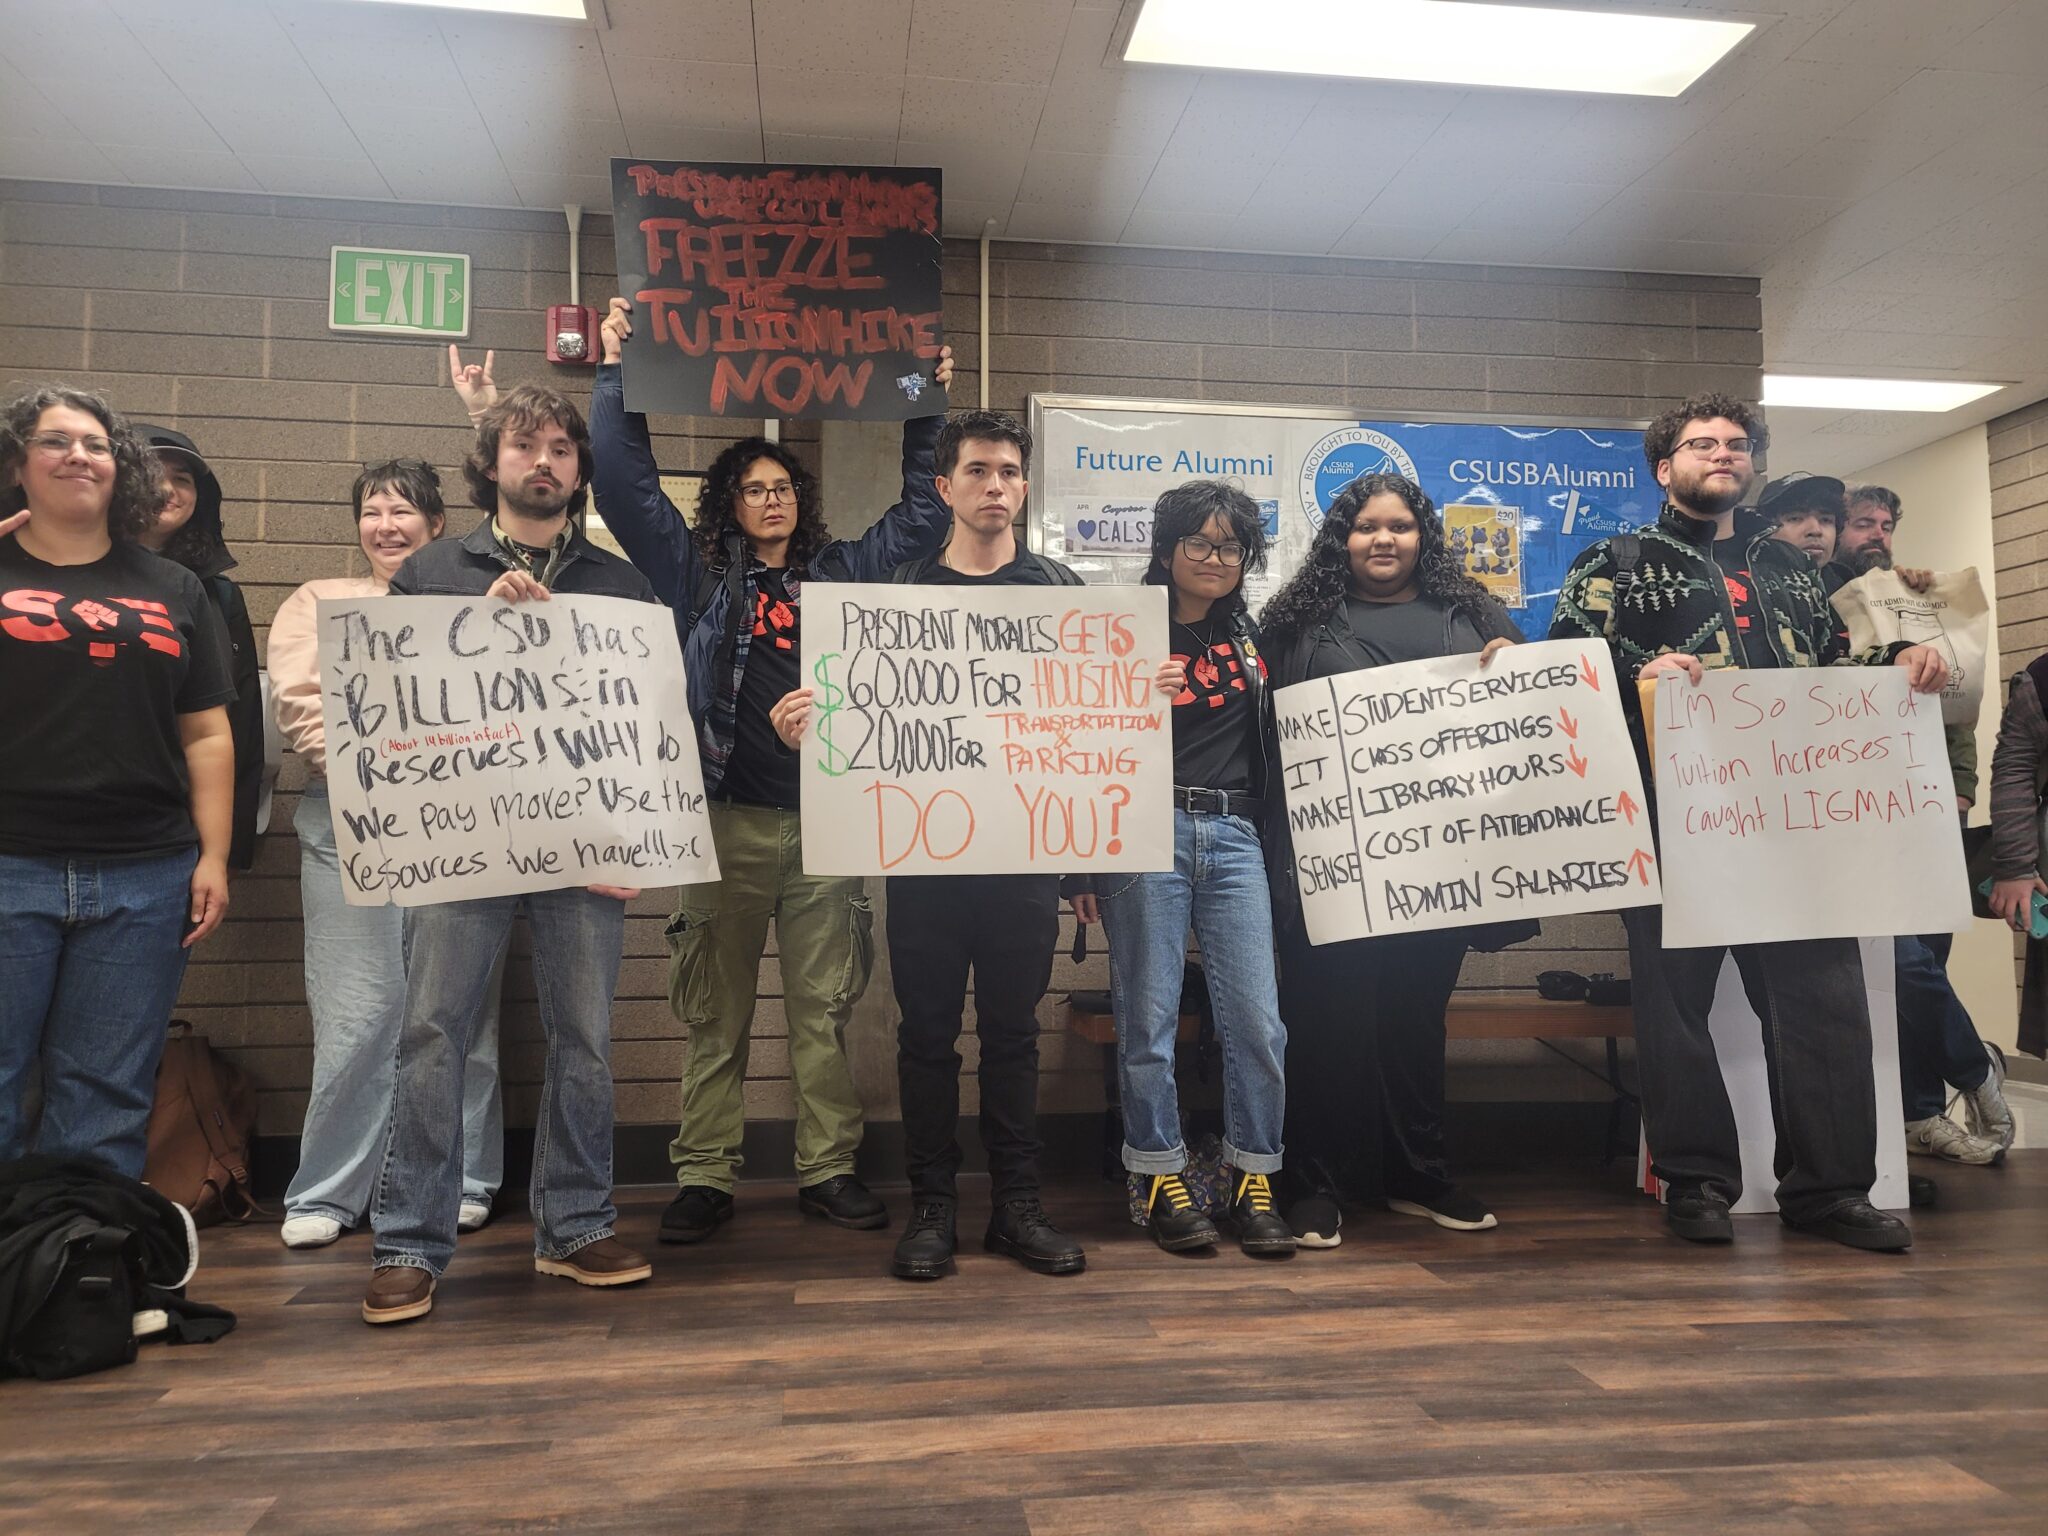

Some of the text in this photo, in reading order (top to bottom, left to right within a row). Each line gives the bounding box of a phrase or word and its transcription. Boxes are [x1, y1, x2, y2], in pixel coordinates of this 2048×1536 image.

[354, 258, 453, 327] EXIT
[710, 352, 874, 415] NOW
[1075, 446, 1274, 476] Future Alumni
[1304, 433, 1345, 481] BROUGHT
[1346, 431, 1362, 441] TO
[1365, 432, 1391, 450] YOU
[1389, 447, 1406, 460] BY
[1321, 465, 1354, 475] Alumni
[1331, 461, 1354, 469] CSUSB
[1497, 510, 1514, 521] $20
[1870, 599, 1883, 608] CUT
[331, 605, 651, 663] The CSU has
[841, 601, 959, 651] PRESIDENT
[966, 613, 1059, 654] MORALES
[1058, 608, 1137, 658] GETS
[598, 668, 639, 707] in
[1030, 657, 1153, 709] HOUSING
[1733, 682, 1787, 730] So
[425, 735, 436, 748] 14
[437, 732, 471, 746] billion
[474, 730, 485, 741] in
[553, 719, 643, 771] WHY
[656, 720, 681, 764] do
[986, 710, 1164, 739] TRANSPORTATION
[1277, 708, 1337, 743] MAKE
[1420, 715, 1554, 759] OFFERINGS
[1000, 742, 1142, 776] PARKING
[1284, 756, 1330, 790] IT
[1669, 731, 1926, 790] Tuition Increases I
[343, 777, 704, 845] We pay more? Use the
[863, 780, 1132, 871] DO YOU?
[1291, 794, 1350, 833] MAKE
[1365, 796, 1618, 860] COST OF ATTENDANCE
[1784, 780, 1918, 831] LIGMA!
[1299, 852, 1361, 896] SENSE
[1384, 860, 1631, 922] ADMIN SALARIES
